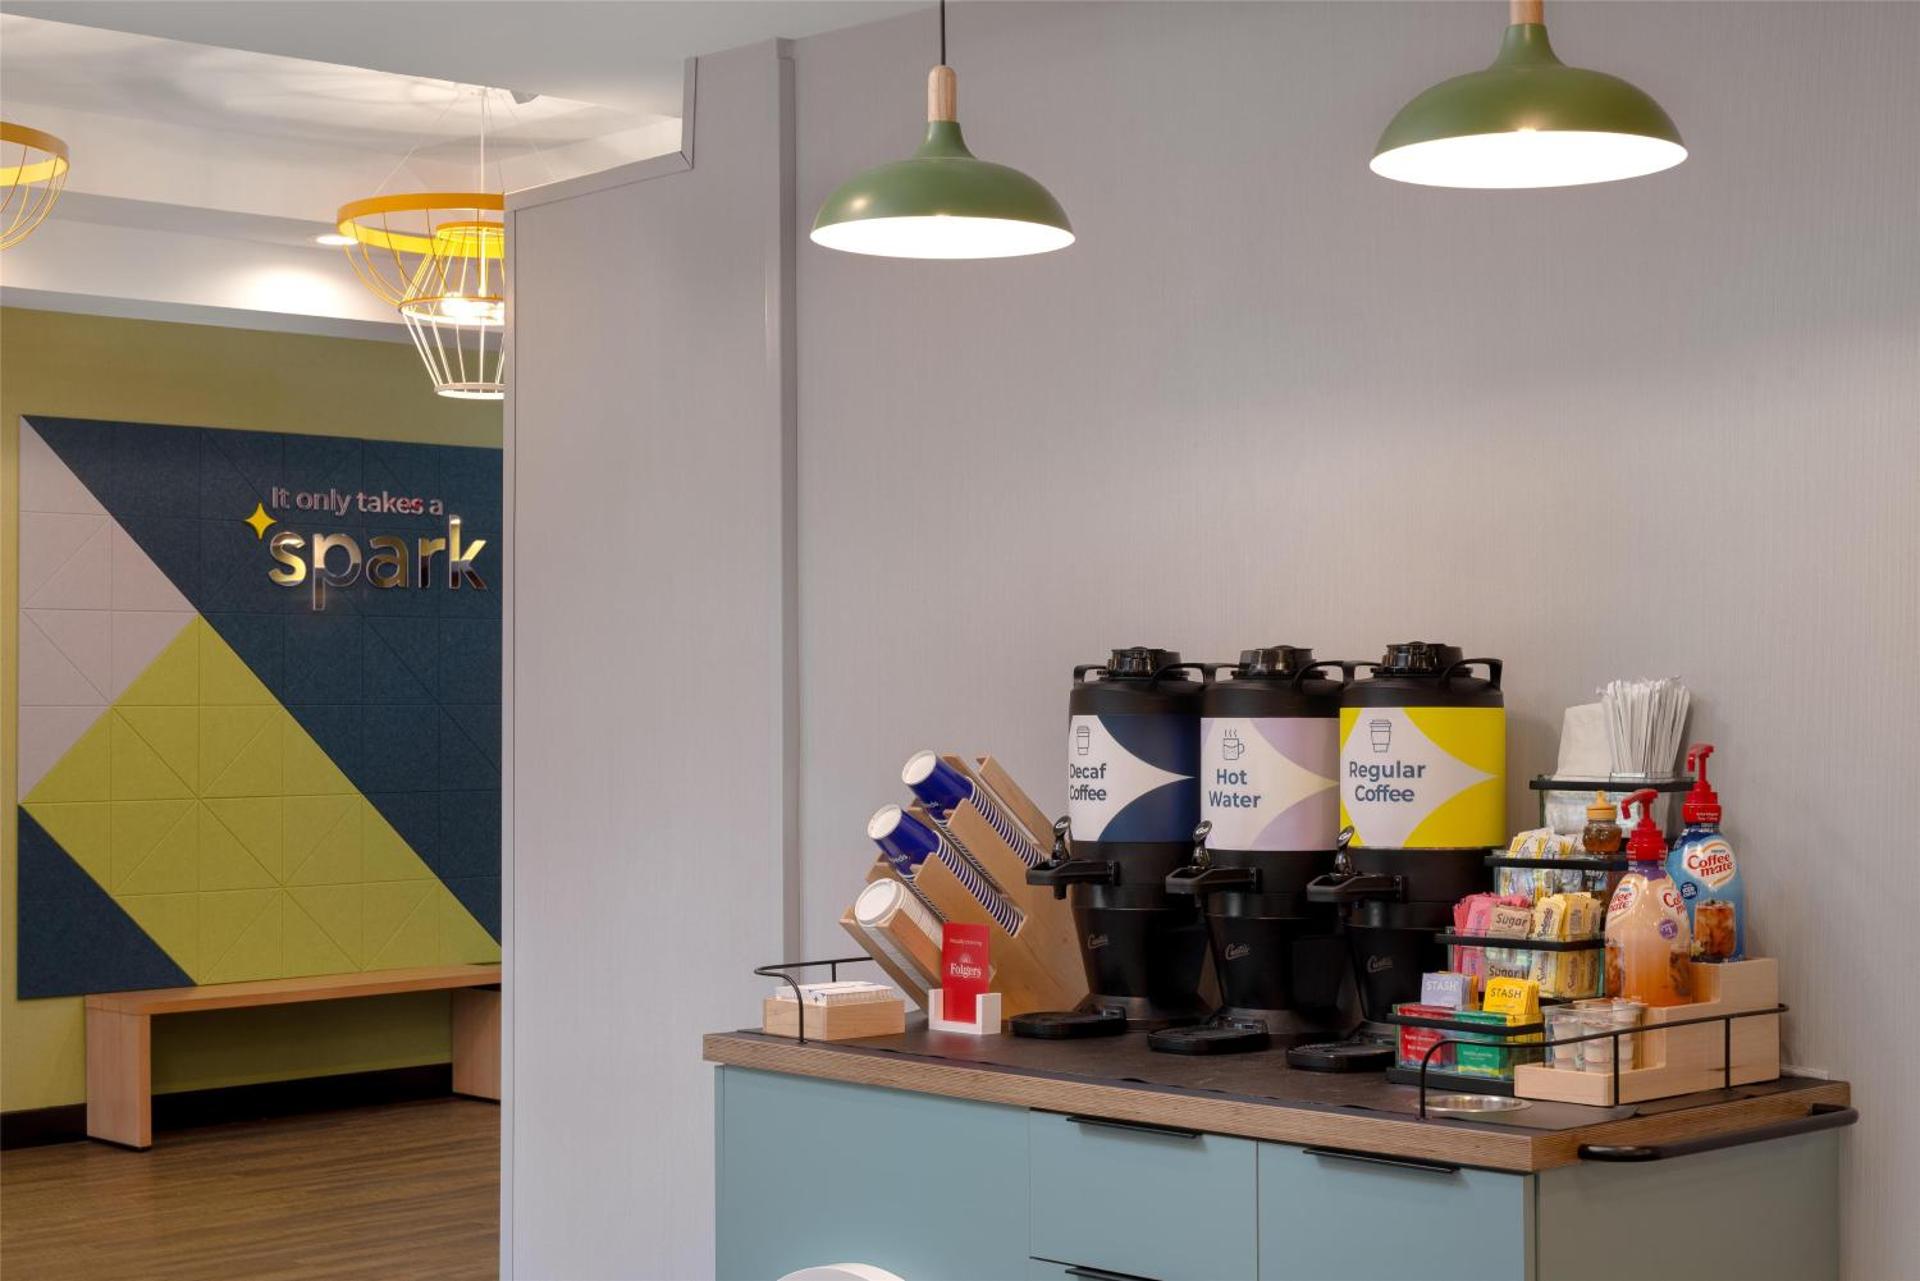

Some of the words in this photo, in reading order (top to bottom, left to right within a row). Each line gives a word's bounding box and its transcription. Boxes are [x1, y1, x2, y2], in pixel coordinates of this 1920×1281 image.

[271, 486, 290, 510] It
[296, 487, 351, 517] only
[356, 490, 424, 515] takes
[428, 499, 443, 516] a
[267, 513, 488, 611] spark
[1069, 762, 1107, 779] Decaf
[1216, 768, 1248, 785] Hot
[1349, 760, 1426, 782] Regular
[1069, 784, 1107, 801] Coffee
[1208, 790, 1262, 808] Water
[1354, 784, 1415, 802] Coffee
[1687, 852, 1730, 870] Coffee
[1700, 861, 1733, 877] mate
[1495, 912, 1528, 928] Sugar
[950, 962, 982, 979] Folgers
[1425, 980, 1457, 991] STASH
[1490, 987, 1522, 999] STASH
